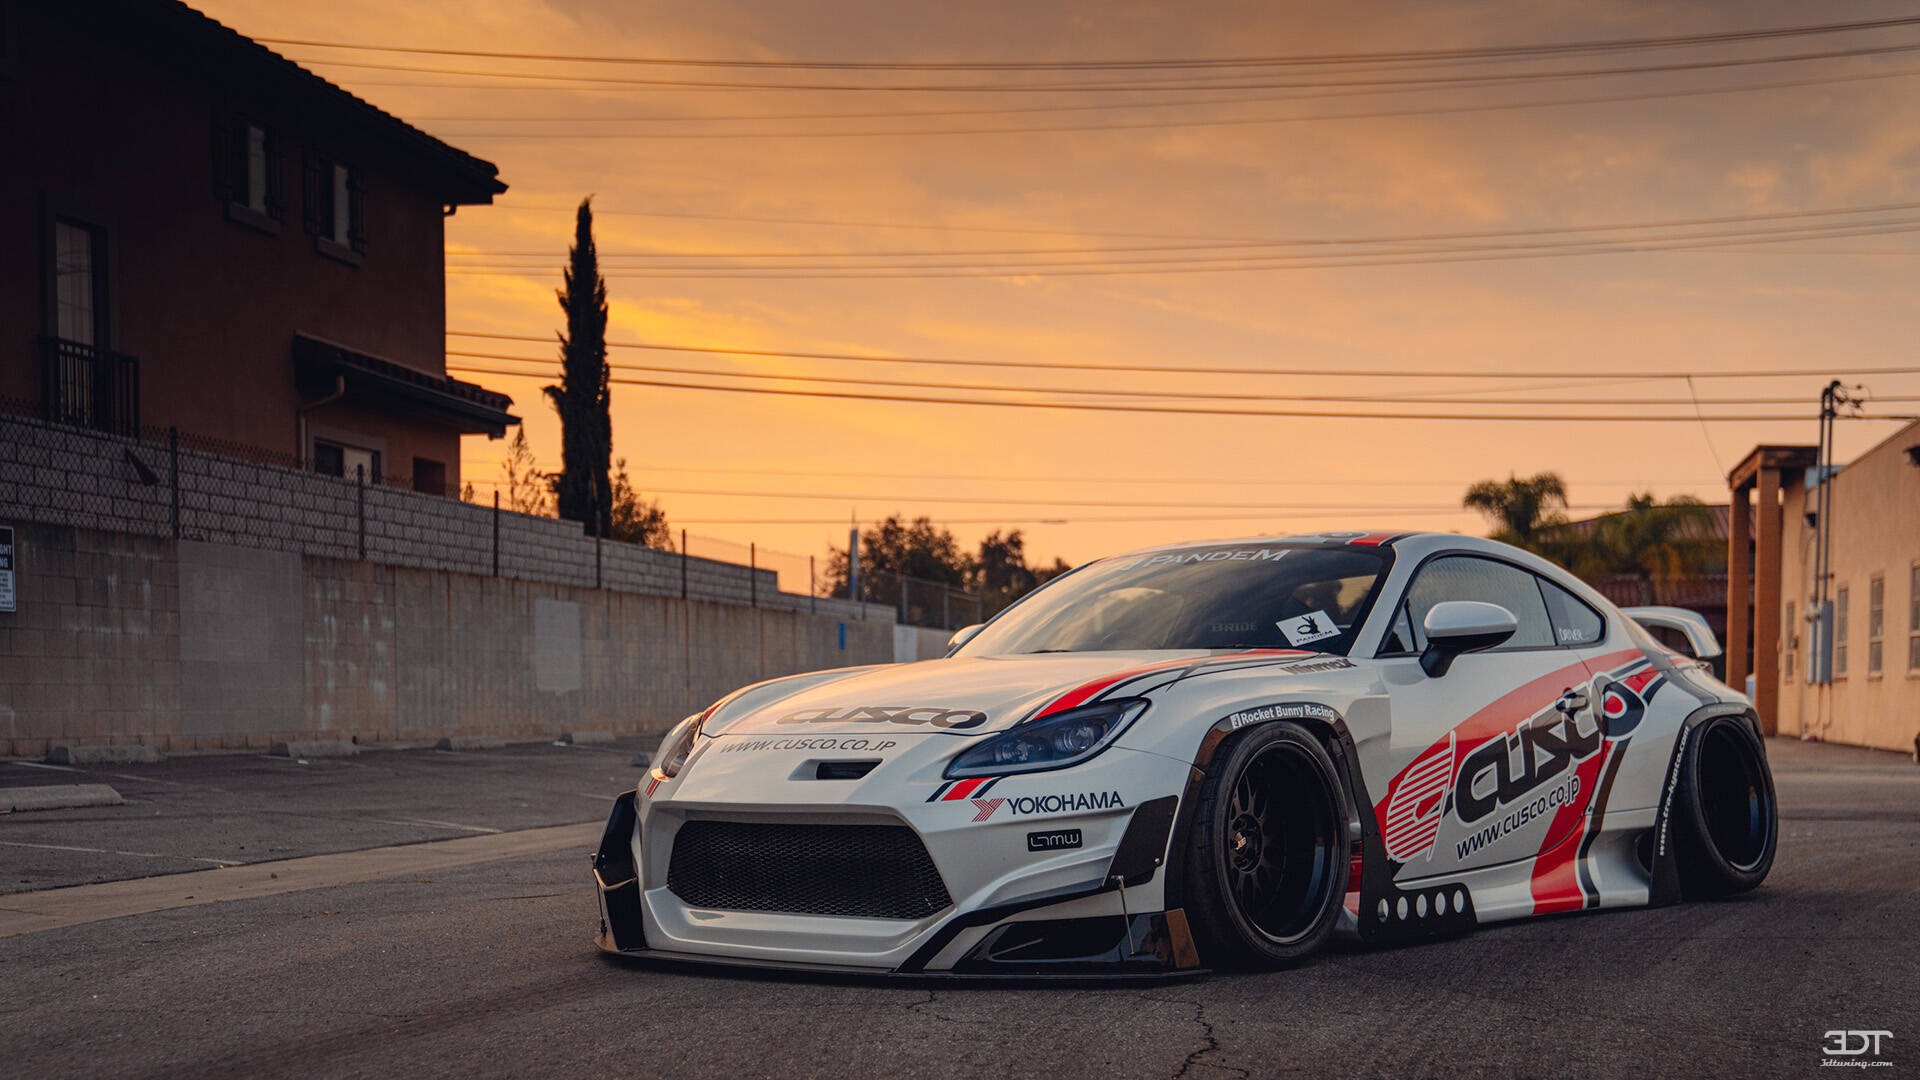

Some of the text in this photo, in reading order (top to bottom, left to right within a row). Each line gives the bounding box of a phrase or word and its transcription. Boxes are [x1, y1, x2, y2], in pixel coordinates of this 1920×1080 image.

[776, 706, 988, 729] CUSCO
[1240, 704, 1335, 725] Rocket Bunny Racing
[1007, 791, 1125, 815] YOKOHAMA
[1456, 775, 1580, 861] www.cusco.co.jp
